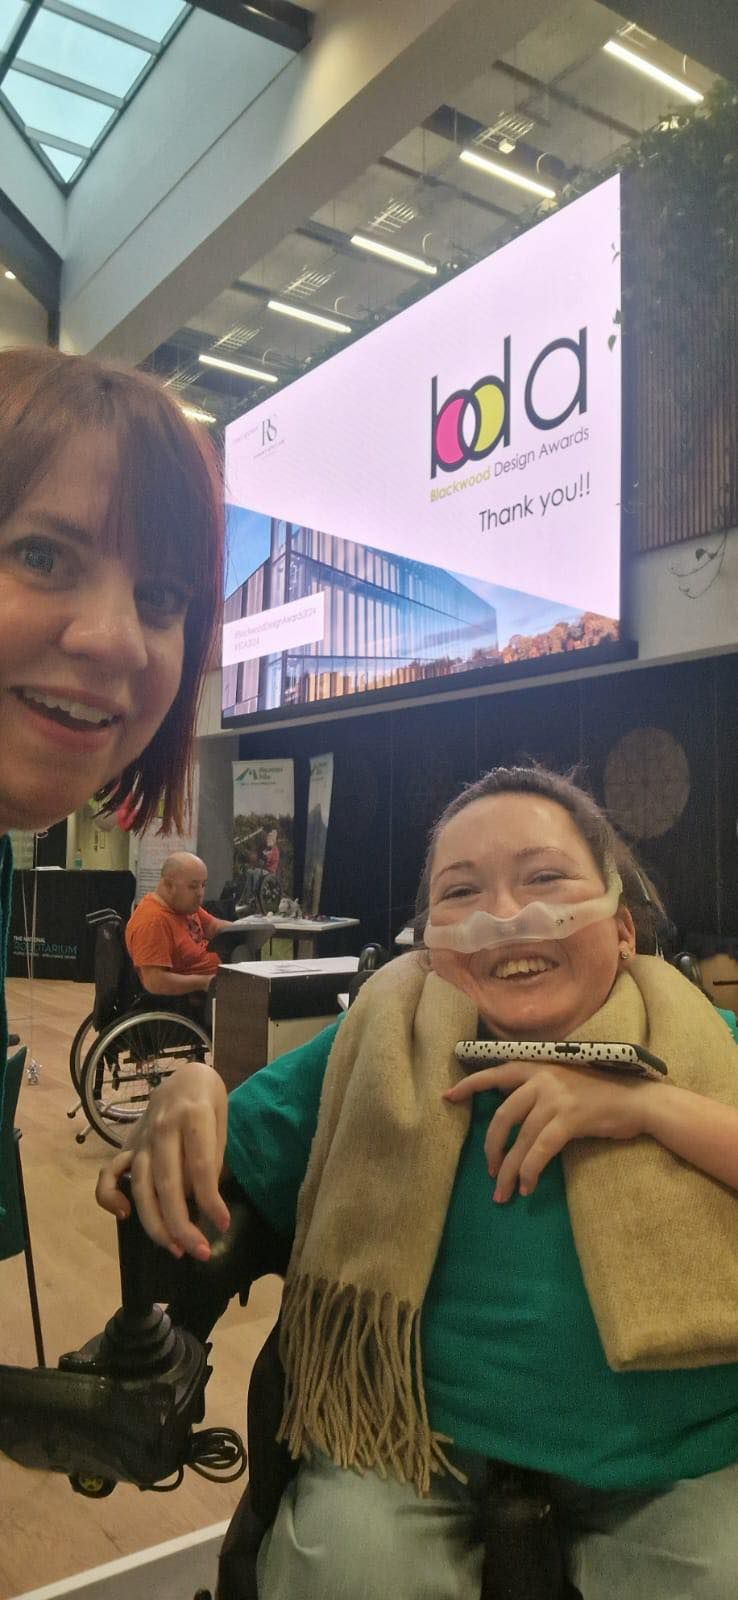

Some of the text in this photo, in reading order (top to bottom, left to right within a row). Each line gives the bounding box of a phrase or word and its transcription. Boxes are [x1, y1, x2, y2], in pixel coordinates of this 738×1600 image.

[430, 326, 588, 480] bda
[430, 426, 590, 503] Blackwood Design Awards
[479, 472, 591, 532] Thank you!!
